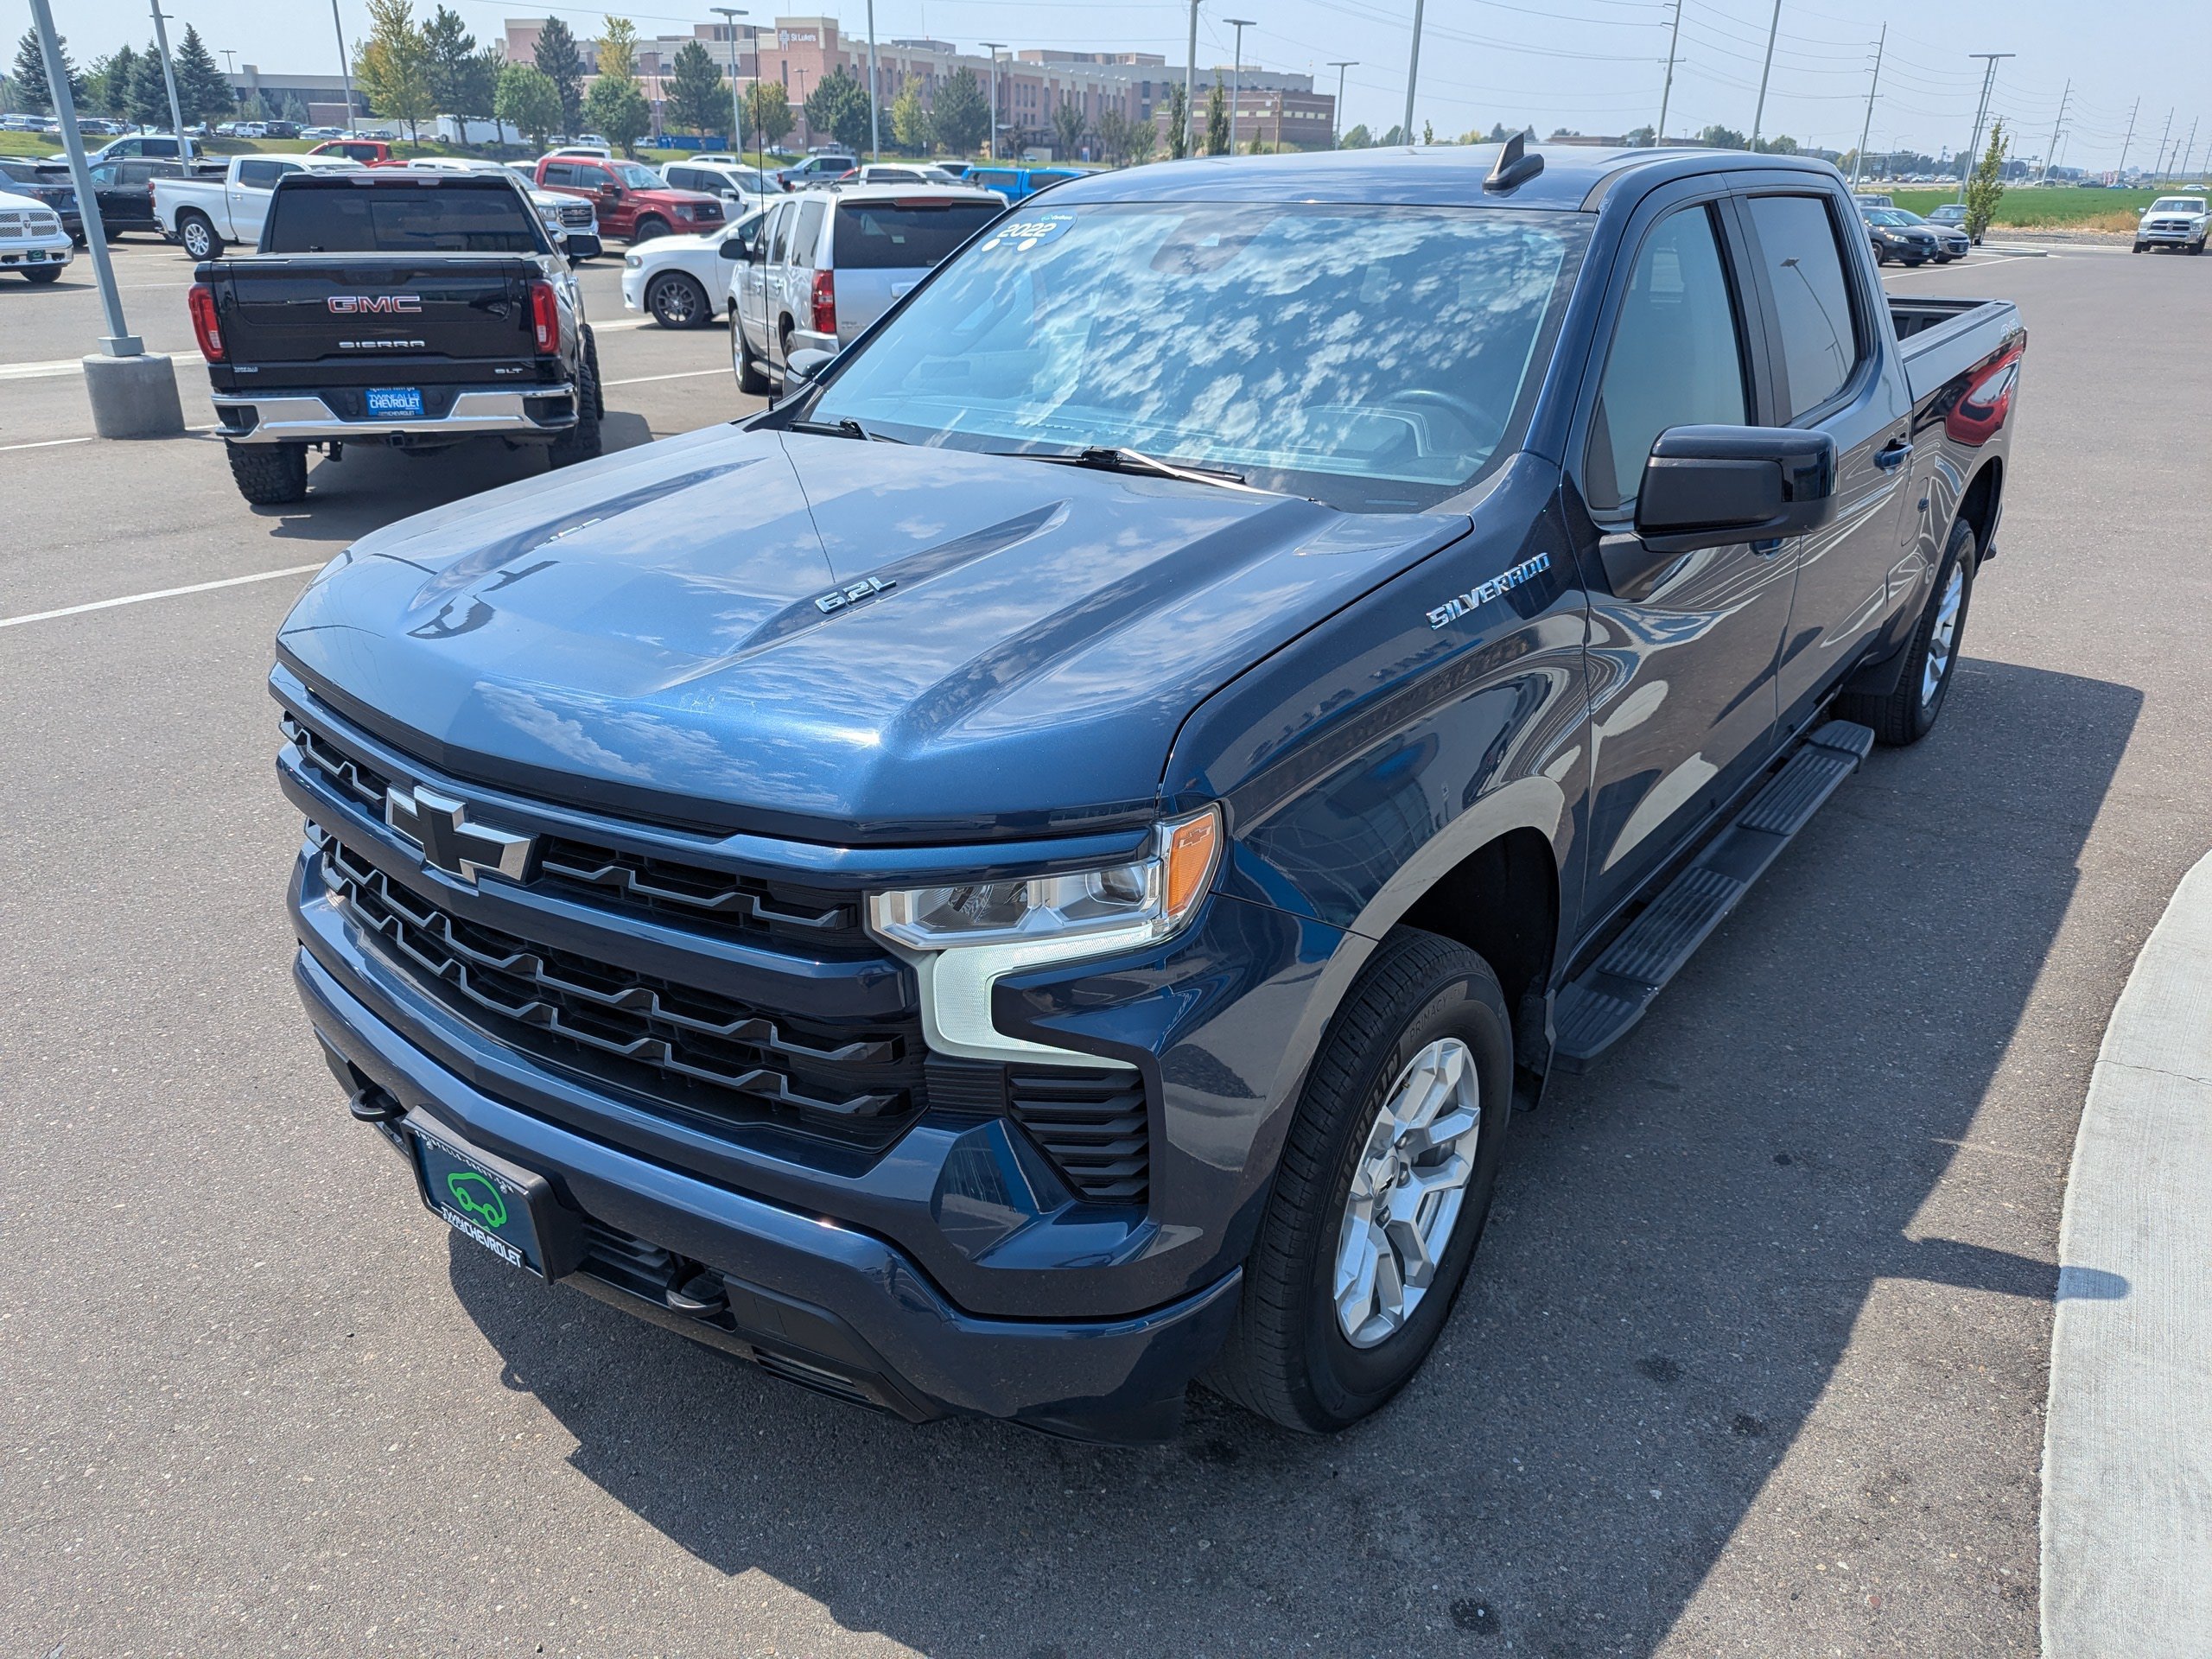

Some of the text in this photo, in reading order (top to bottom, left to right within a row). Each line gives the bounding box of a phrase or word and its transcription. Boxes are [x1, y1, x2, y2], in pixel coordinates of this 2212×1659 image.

[996, 223, 1057, 238] 2022
[327, 296, 422, 313] GMC
[369, 397, 420, 409] CHEVROLET
[815, 576, 897, 614] 6.2L
[1426, 552, 1552, 631] SILVERADO
[1333, 1051, 1402, 1210] MICHELIN
[464, 1221, 521, 1268] CHEVROLET
